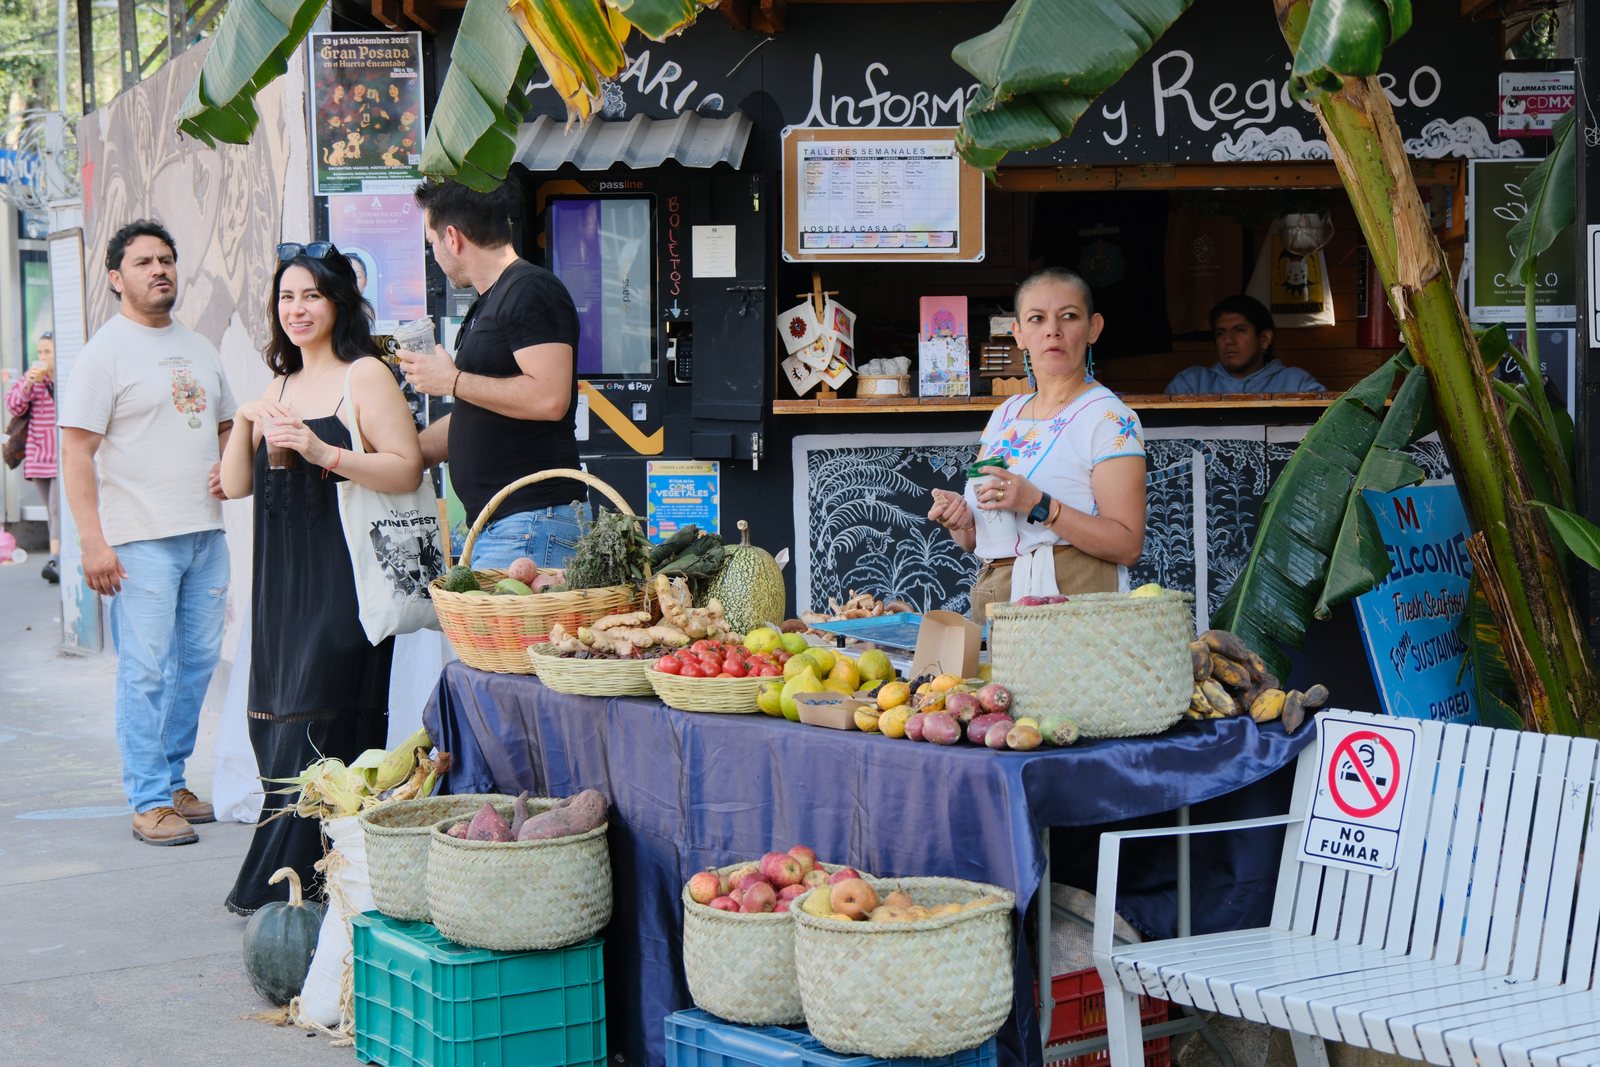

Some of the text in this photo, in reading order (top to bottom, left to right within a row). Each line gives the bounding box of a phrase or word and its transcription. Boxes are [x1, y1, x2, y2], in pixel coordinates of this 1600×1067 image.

[320, 46, 410, 60] Gran Posada
[1527, 96, 1572, 108] CDMX
[600, 180, 644, 191] passline
[667, 196, 682, 296] BOLETOS
[636, 382, 652, 392] Pay
[371, 516, 436, 528] WINE FEST
[1392, 496, 1422, 531] M
[1373, 532, 1472, 592] ELCOME
[1392, 592, 1426, 624] Fresh
[1390, 631, 1412, 681] From
[1430, 690, 1470, 720] PAIRED
[1340, 827, 1365, 842] NO
[1320, 840, 1379, 862] FUMAR
